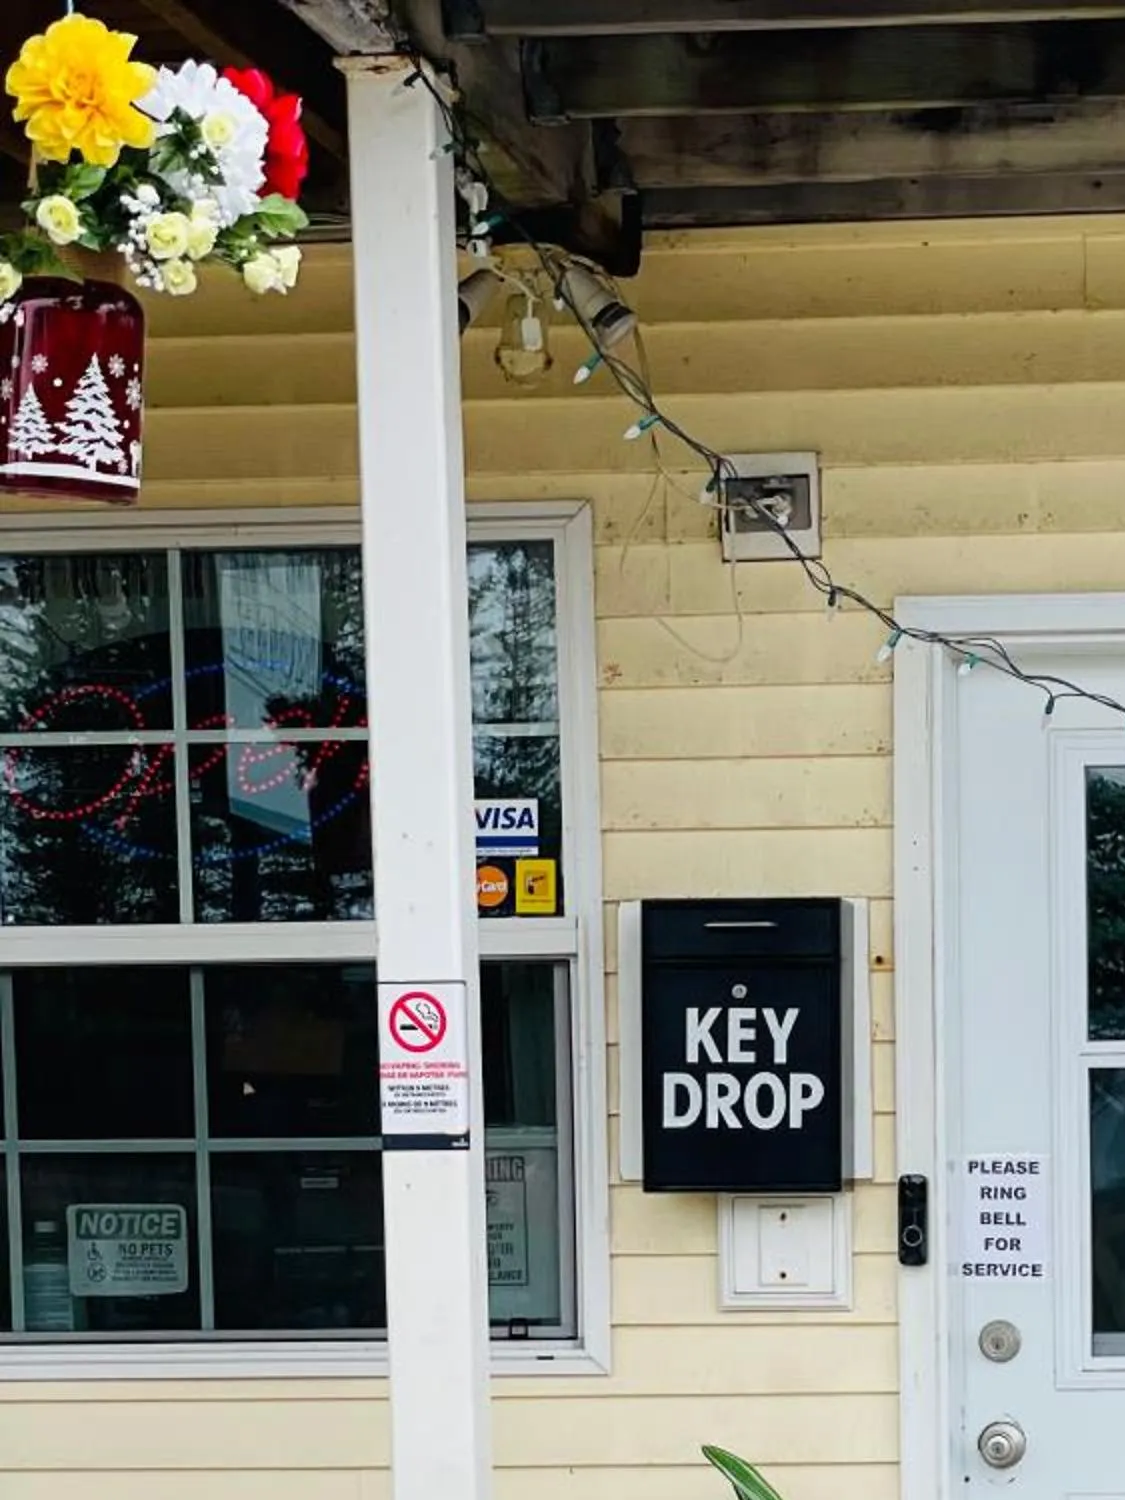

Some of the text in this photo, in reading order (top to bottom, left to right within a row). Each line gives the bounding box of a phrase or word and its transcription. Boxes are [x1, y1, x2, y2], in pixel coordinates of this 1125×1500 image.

[474, 807, 535, 829] VISA
[685, 1007, 800, 1065] KEY
[662, 1072, 825, 1130] DROP
[968, 1160, 1040, 1175] PLEASE
[980, 1186, 1027, 1200] RING
[80, 1212, 179, 1235] NOTICE
[979, 1211, 1027, 1226] BELL
[118, 1242, 173, 1256] NO PETS
[984, 1237, 1022, 1251] FOR
[962, 1263, 1043, 1277] SERVICE
